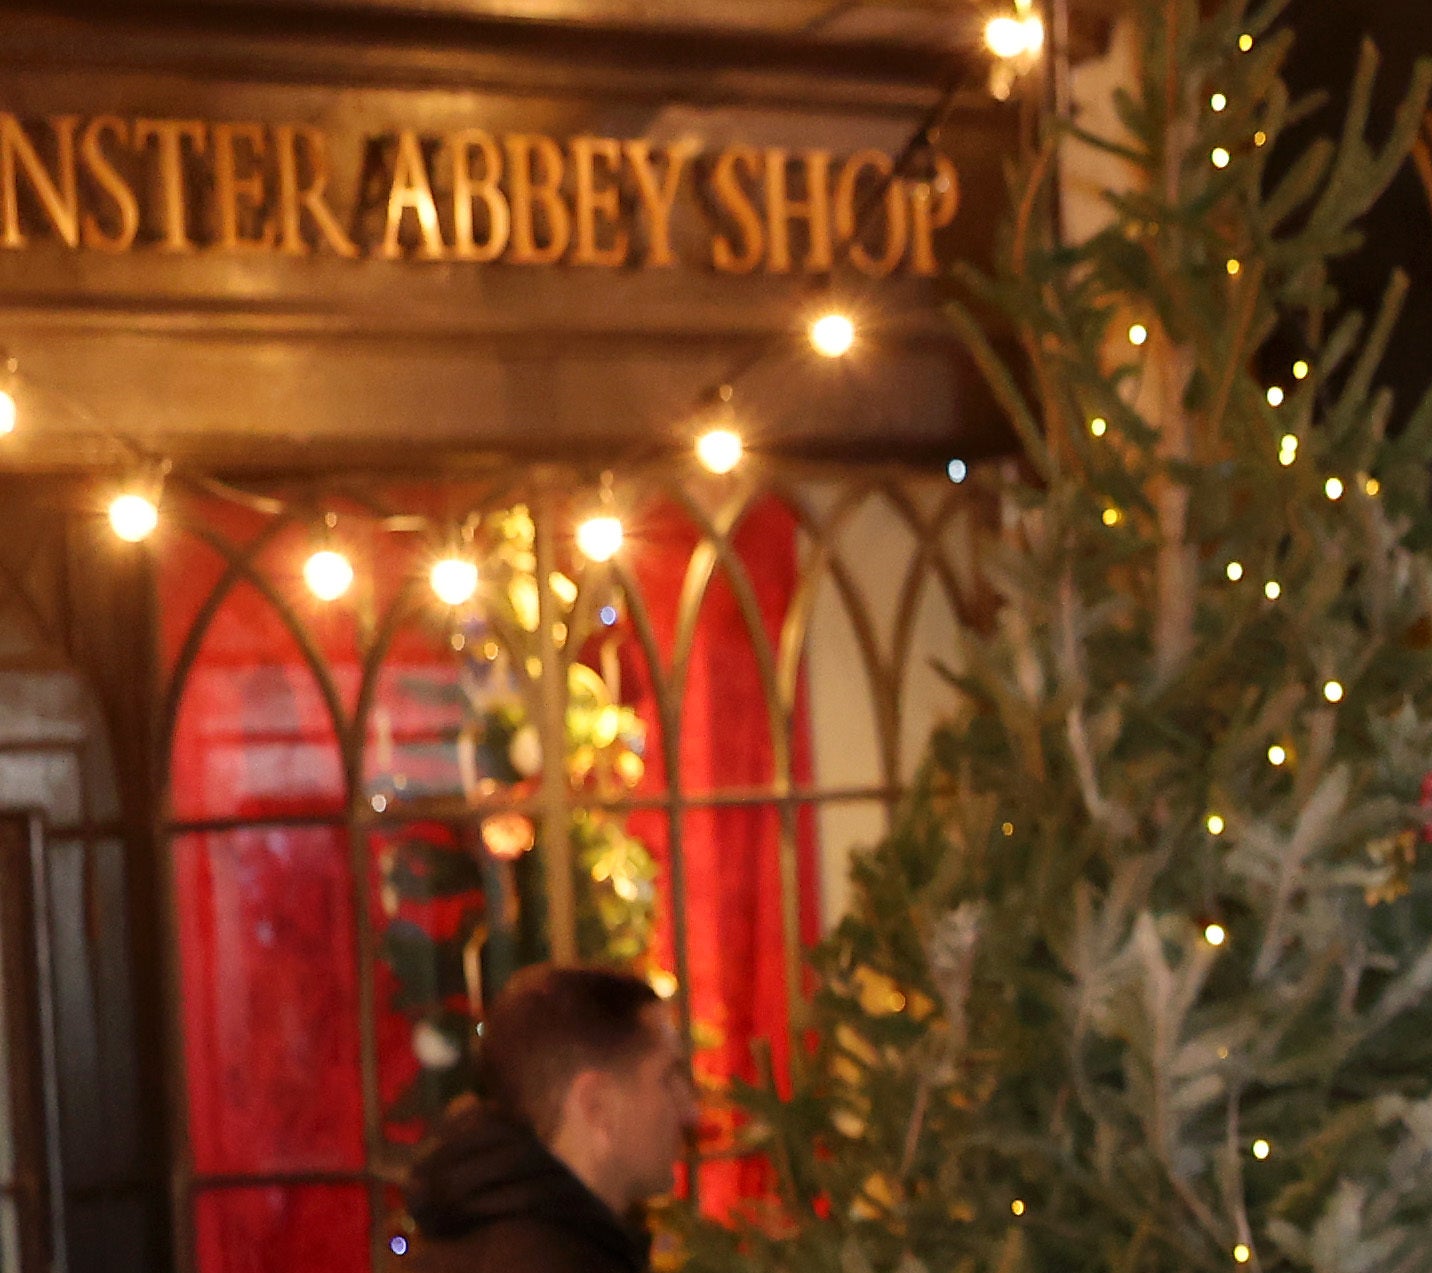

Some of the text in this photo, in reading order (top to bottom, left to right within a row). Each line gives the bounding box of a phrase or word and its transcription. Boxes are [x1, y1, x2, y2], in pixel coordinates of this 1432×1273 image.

[0, 112, 959, 278] NSTER ABBEY SHOP
